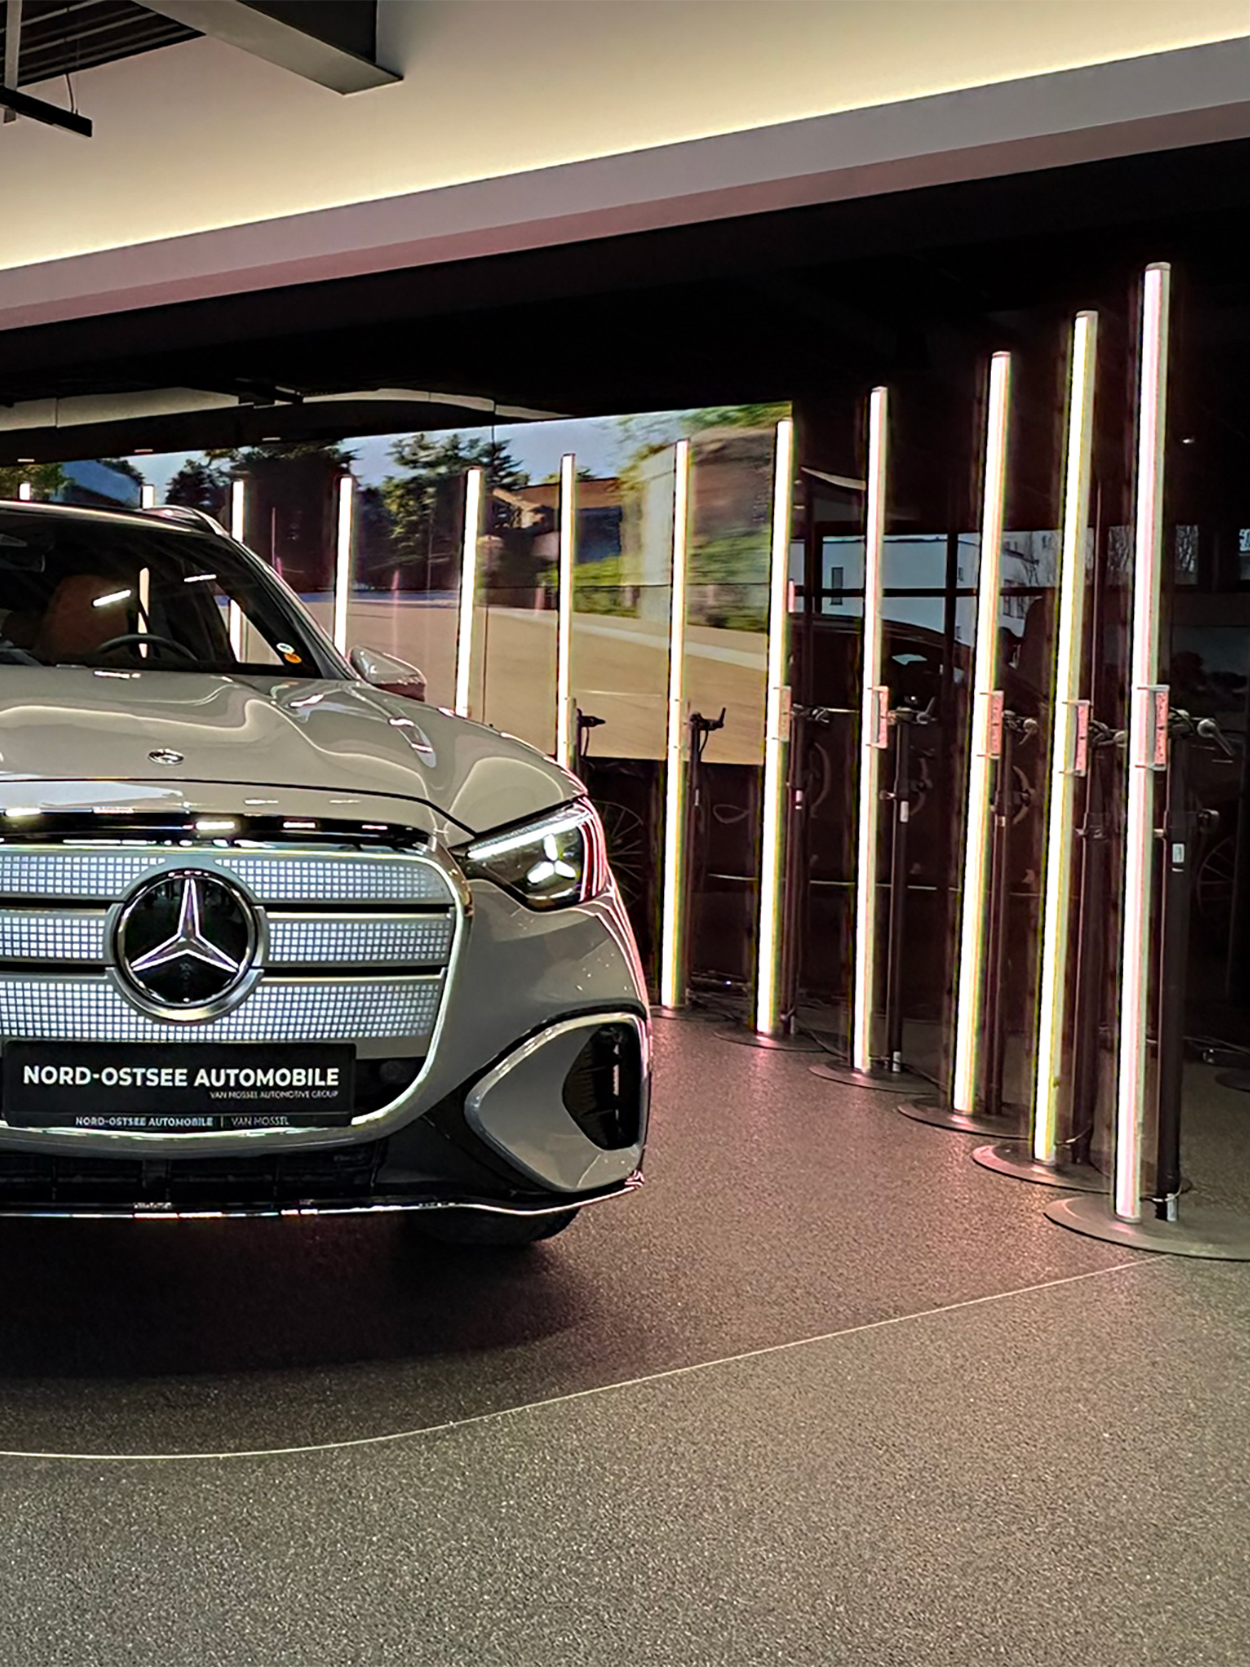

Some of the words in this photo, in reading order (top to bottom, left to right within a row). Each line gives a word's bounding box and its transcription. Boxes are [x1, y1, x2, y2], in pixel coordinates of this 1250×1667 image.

[23, 1066, 188, 1087] NORD-OSTSEE
[193, 1068, 340, 1087] AUTOMOBILE
[209, 1090, 228, 1099] VAN
[229, 1090, 258, 1099] MOSSEL
[260, 1090, 310, 1099] AUTOMOTIVE
[311, 1090, 339, 1099] GROUP
[75, 1116, 147, 1126] NORD-OSTSEE
[148, 1116, 214, 1127] AUTOMOBILE
[231, 1116, 252, 1126] VAN
[253, 1116, 290, 1126] MOSSEL
